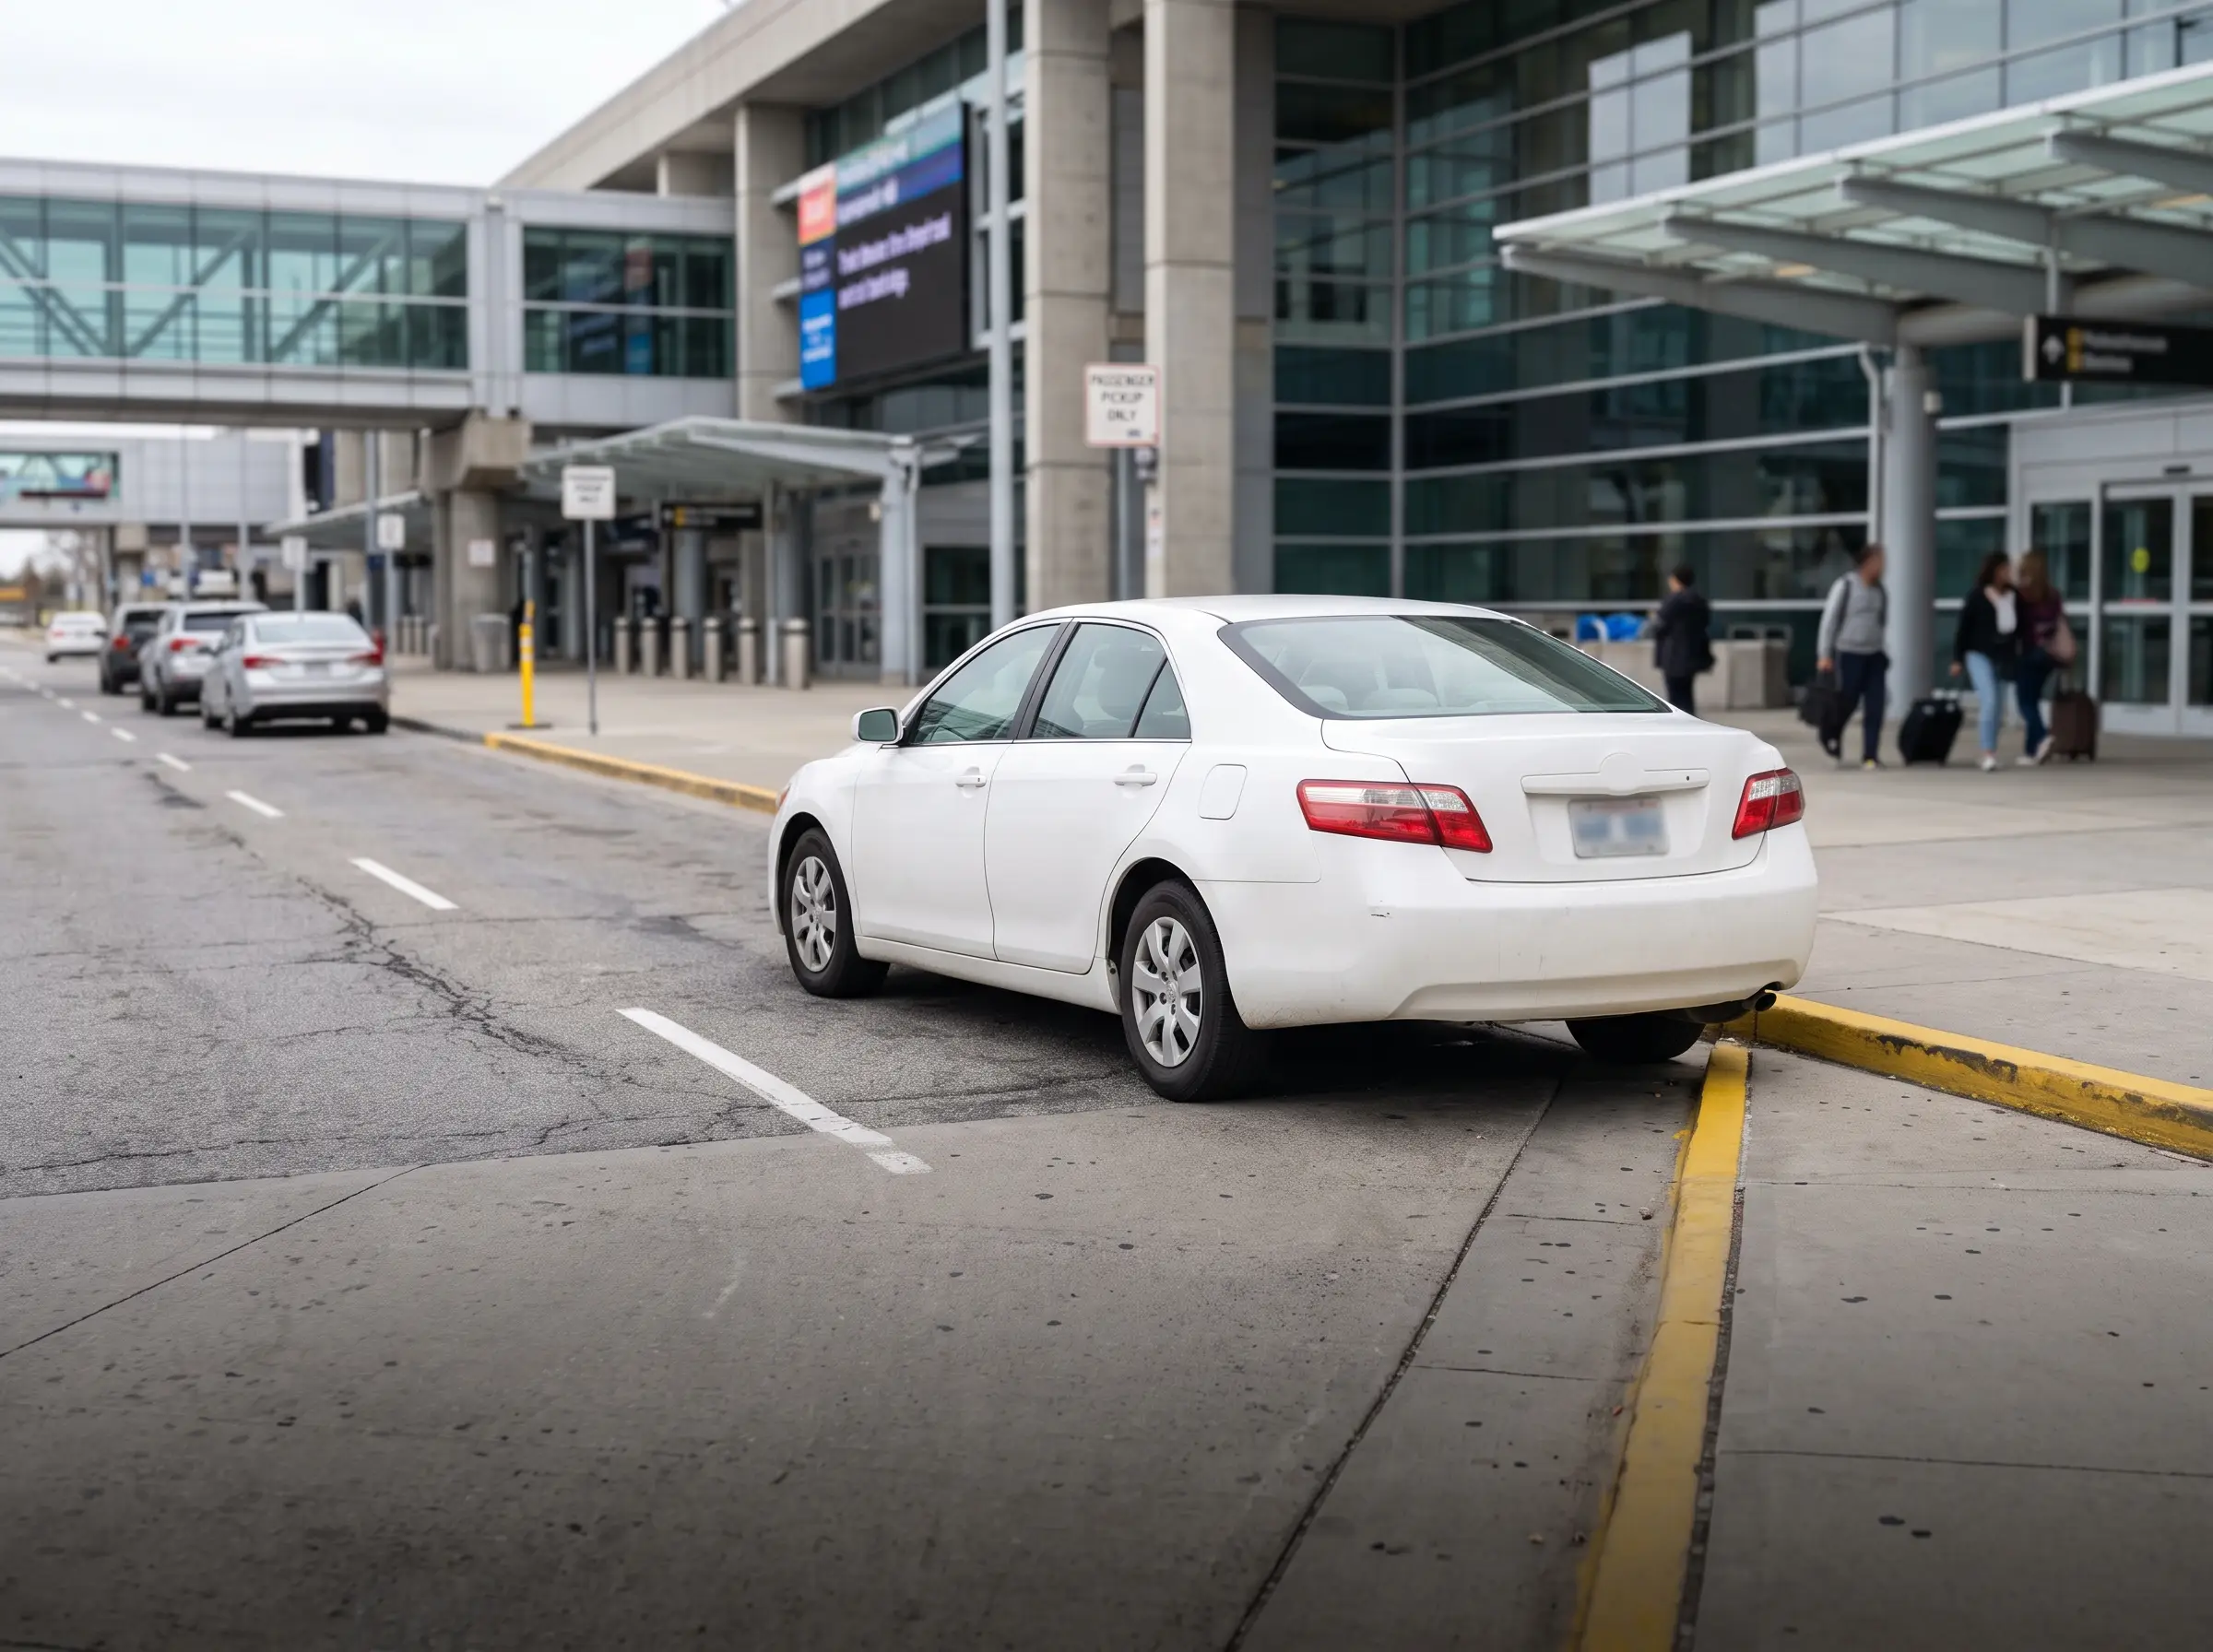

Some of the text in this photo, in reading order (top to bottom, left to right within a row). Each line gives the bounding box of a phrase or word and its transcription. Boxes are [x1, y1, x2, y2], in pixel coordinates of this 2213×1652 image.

[1092, 374, 1154, 386] PASSENGER
[1101, 391, 1143, 403] PICKUP
[1107, 409, 1137, 421] ONLY
